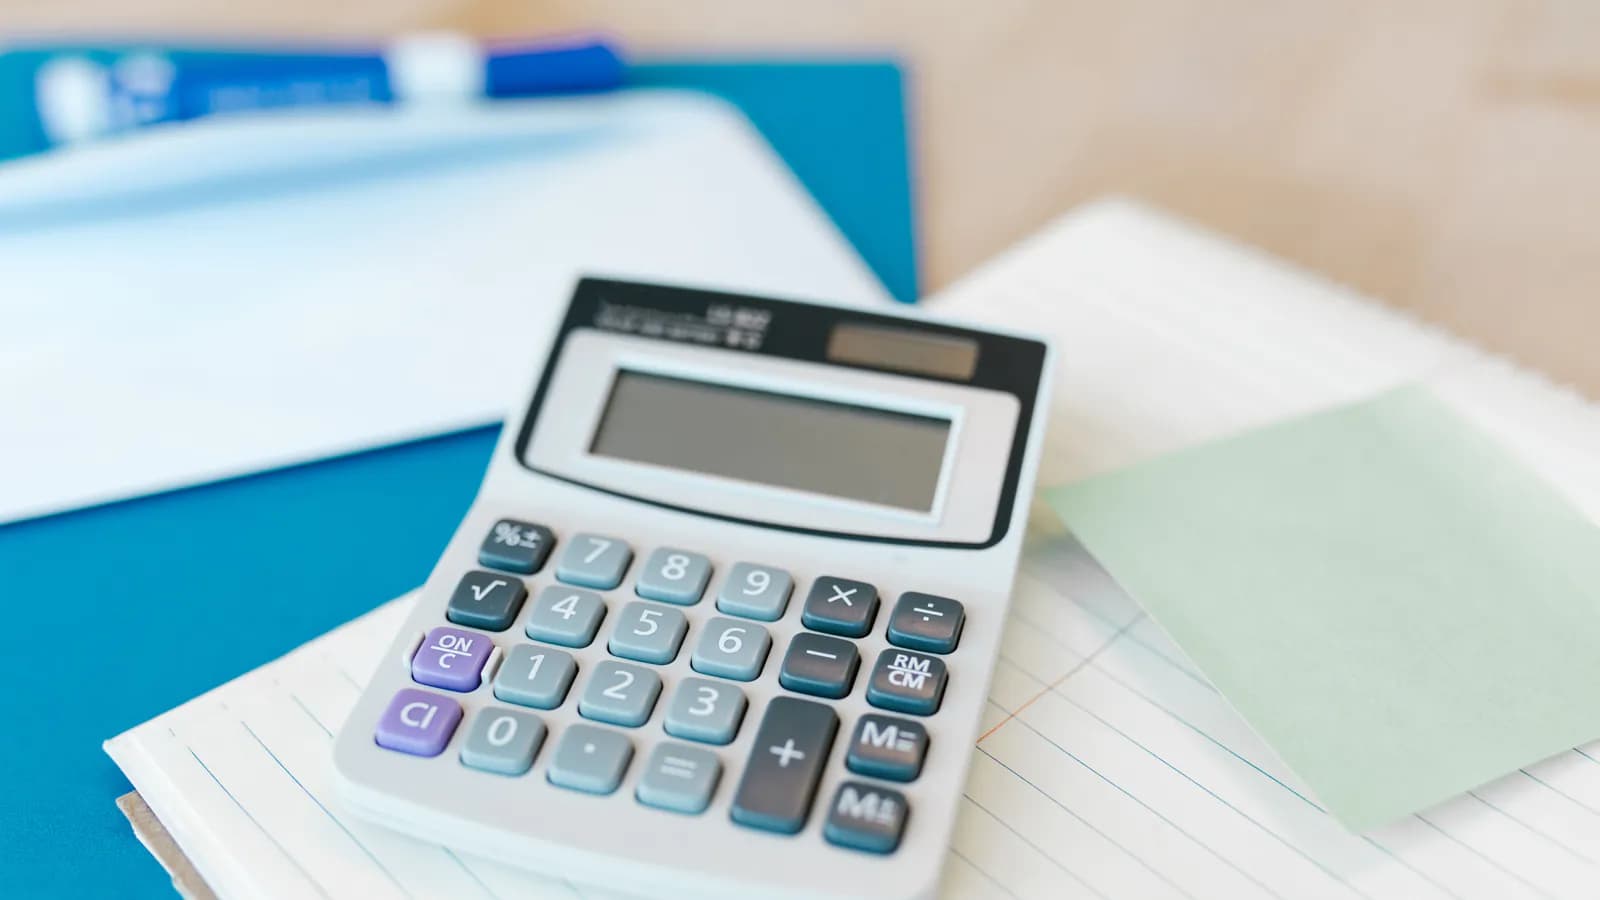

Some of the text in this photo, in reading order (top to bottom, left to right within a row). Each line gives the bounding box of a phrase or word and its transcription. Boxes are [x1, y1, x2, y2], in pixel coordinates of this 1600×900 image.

[584, 539, 611, 563] 7
[661, 555, 690, 580] 8
[743, 571, 770, 595] 9
[551, 595, 580, 620] 4
[634, 610, 663, 635] 5
[439, 635, 472, 652] ON
[718, 628, 746, 653] 6
[439, 653, 456, 668] C
[529, 654, 545, 680] 1
[893, 654, 930, 673] RM
[603, 670, 634, 699] 2
[888, 671, 925, 690] CM
[689, 687, 718, 715] 3
[487, 716, 518, 746] 0
